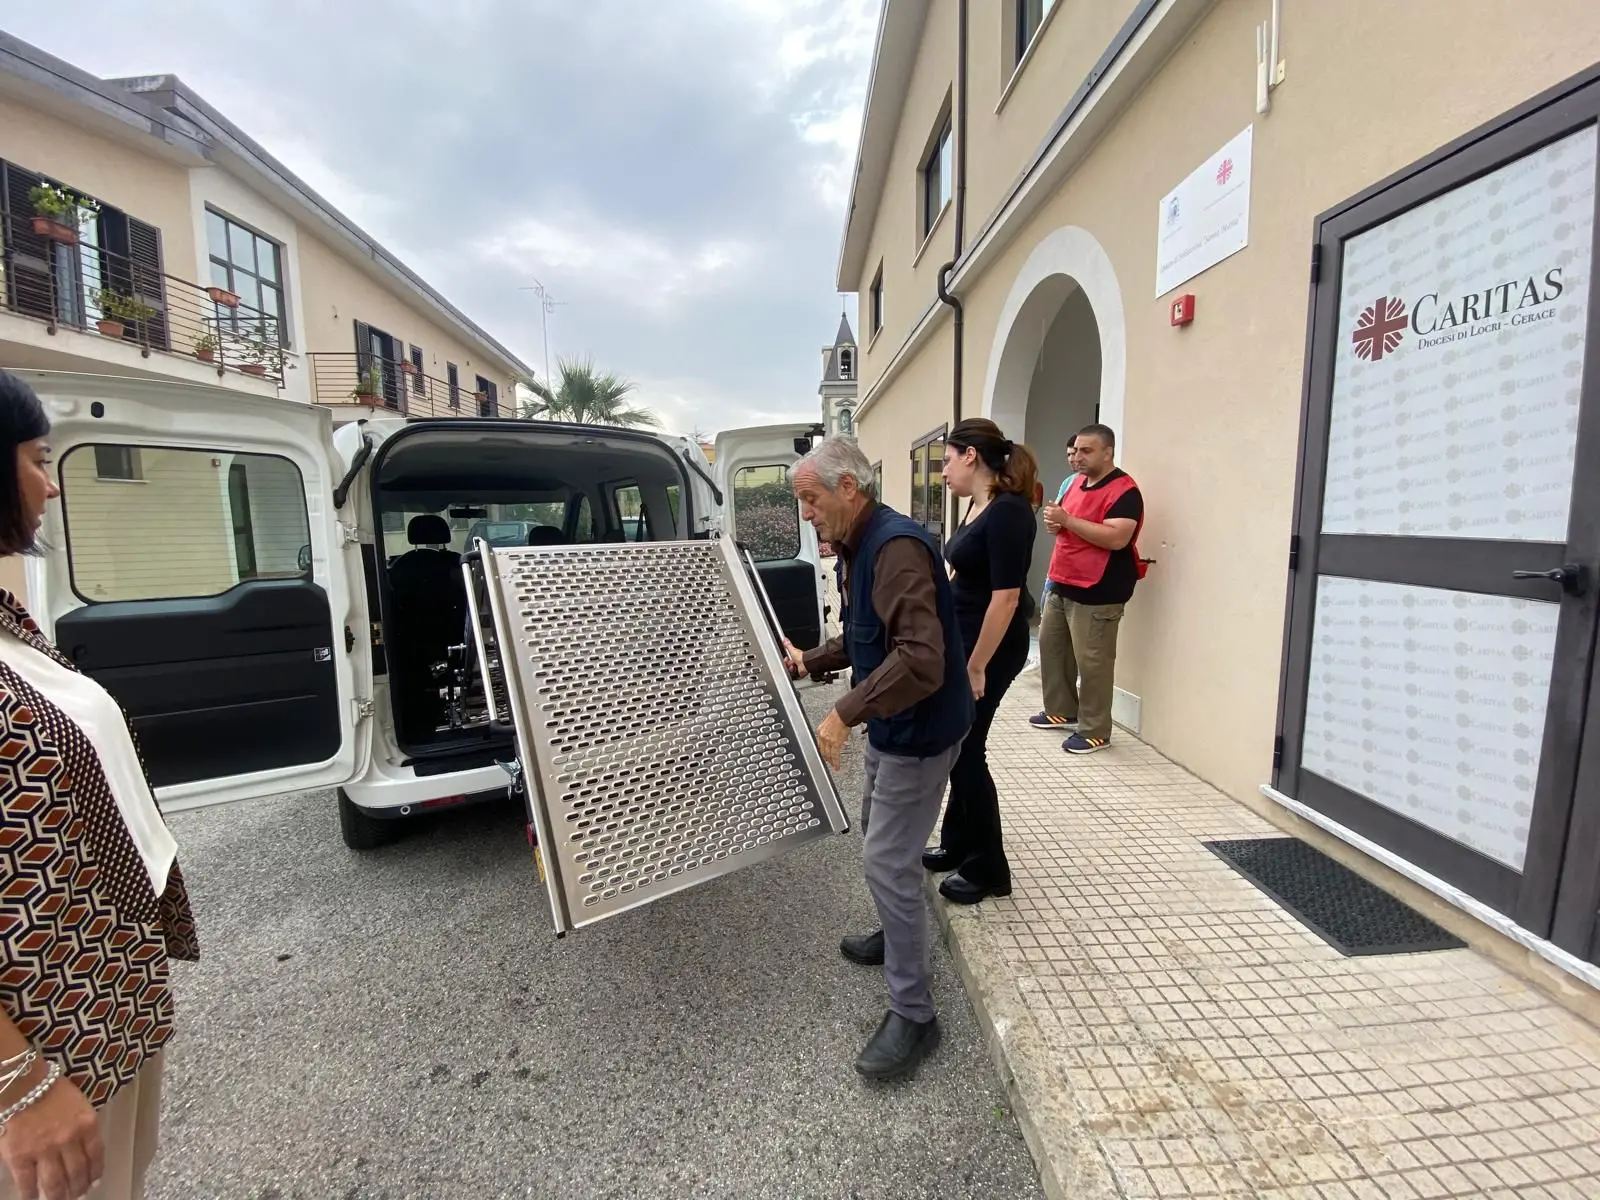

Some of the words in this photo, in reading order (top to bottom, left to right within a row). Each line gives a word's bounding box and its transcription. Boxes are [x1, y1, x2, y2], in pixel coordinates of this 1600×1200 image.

[1411, 267, 1563, 336] CARITAS
[1418, 334, 1455, 350] DIOCESI
[1457, 331, 1467, 342] DI
[1470, 321, 1501, 337] LOCRI
[1511, 308, 1556, 327] GERACE
